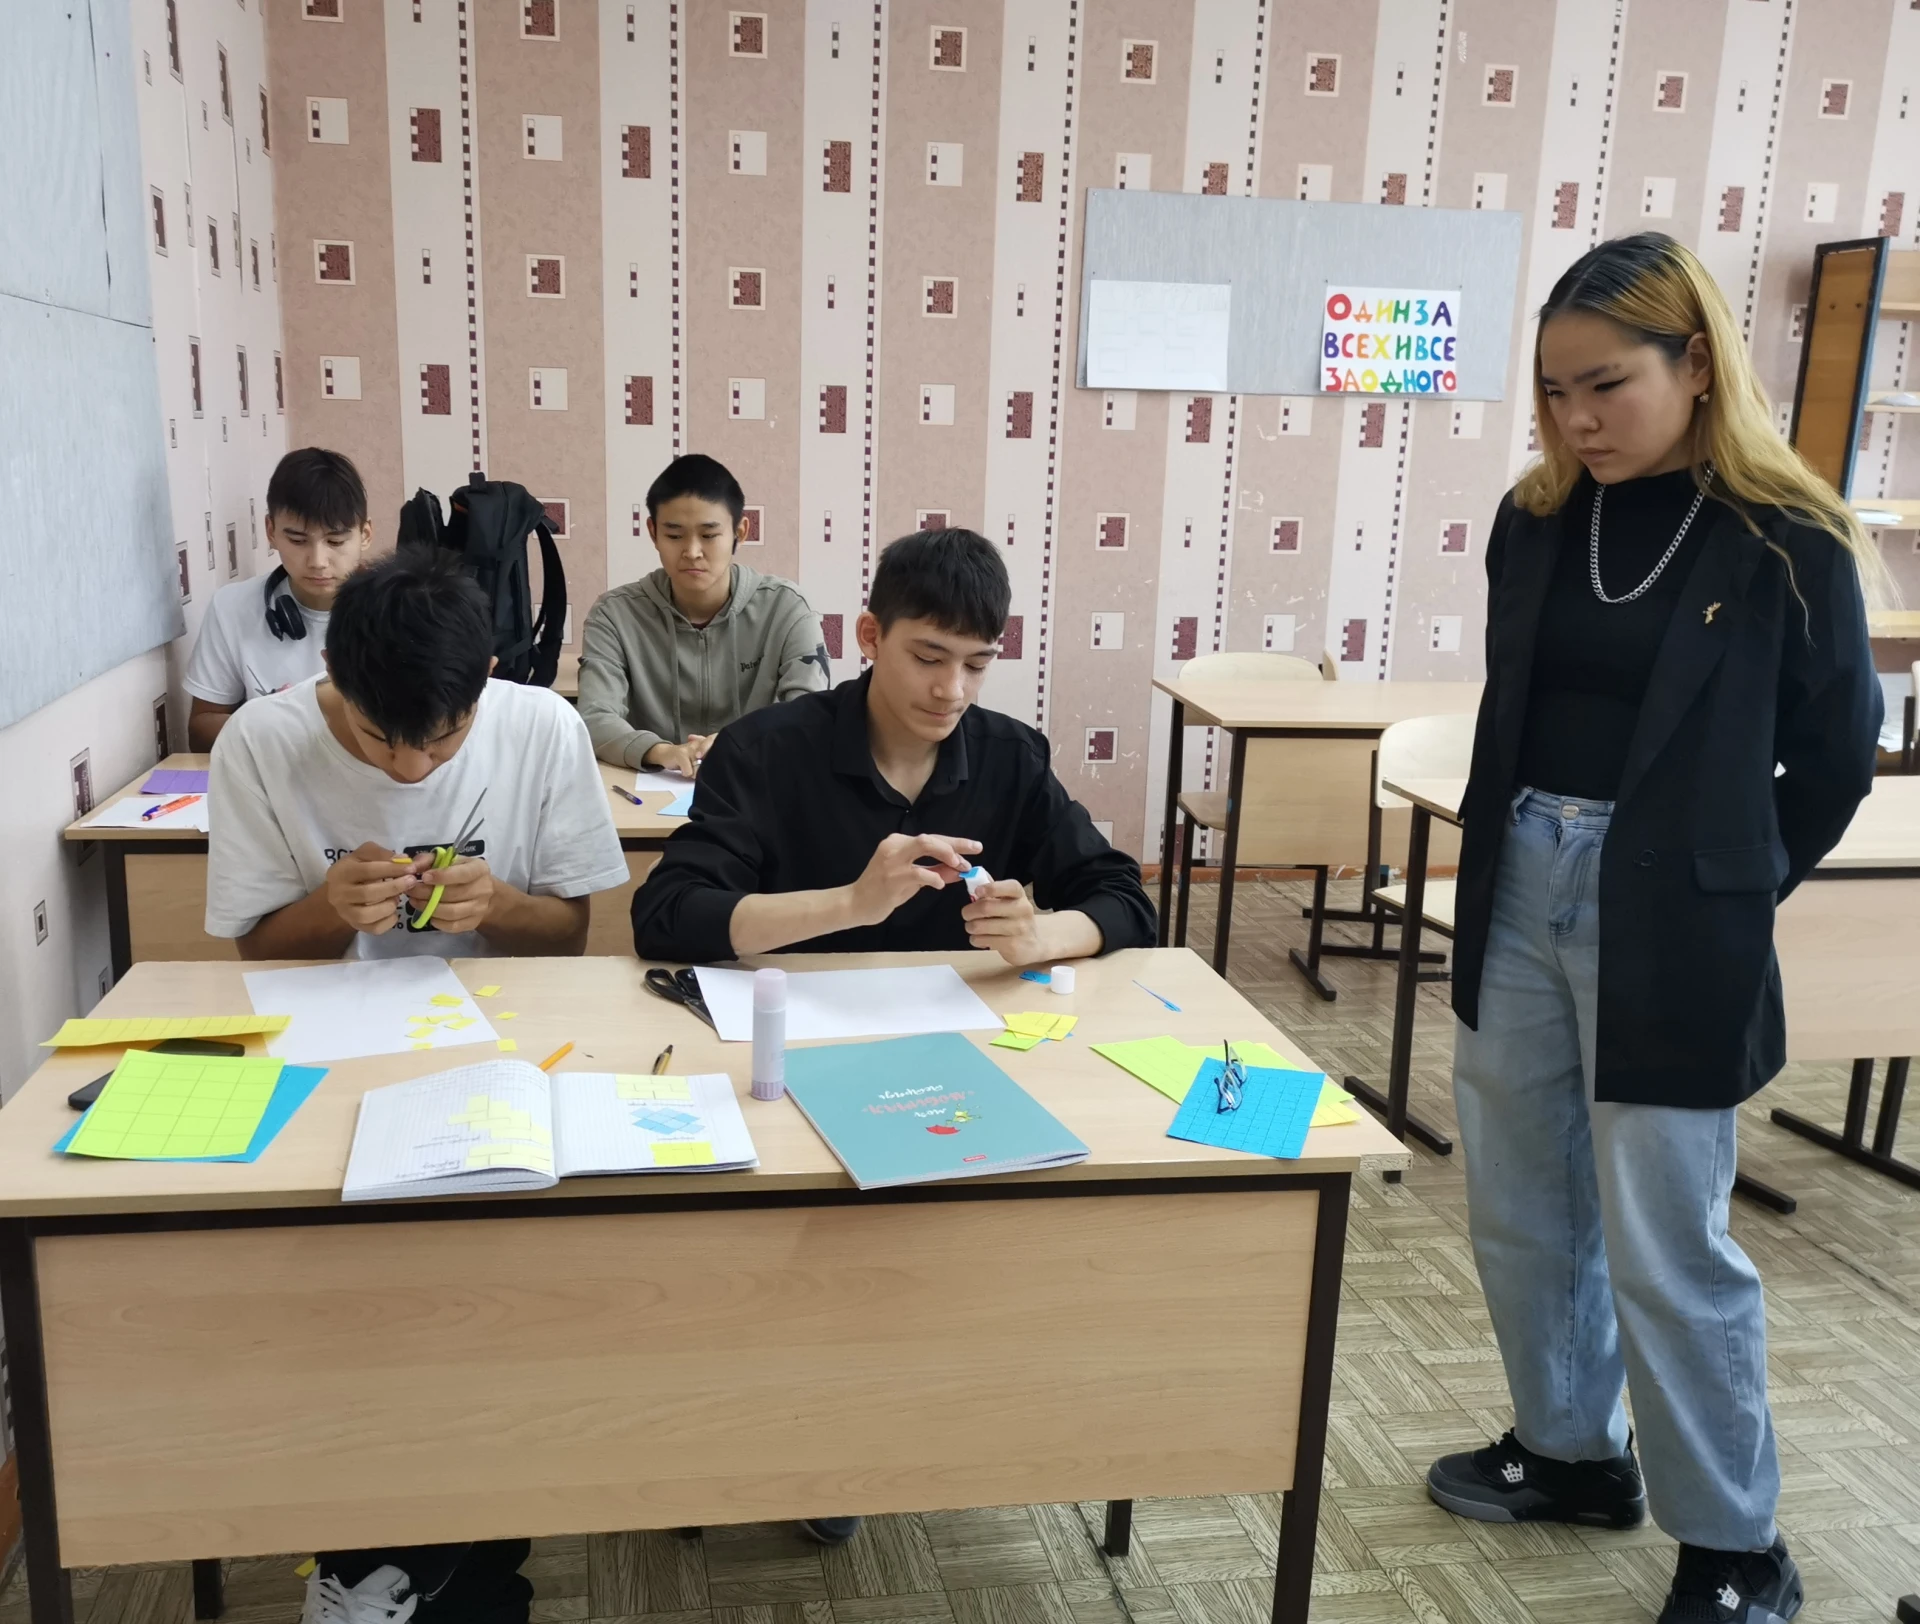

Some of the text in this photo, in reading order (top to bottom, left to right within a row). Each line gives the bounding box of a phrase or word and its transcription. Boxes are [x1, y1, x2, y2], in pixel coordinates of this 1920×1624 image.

[1327, 293, 1453, 327] ОДИН ЗА
[1324, 332, 1457, 362] ВСЕХ И ВСЕ
[1325, 367, 1457, 393] ЗА ОДНОГО
